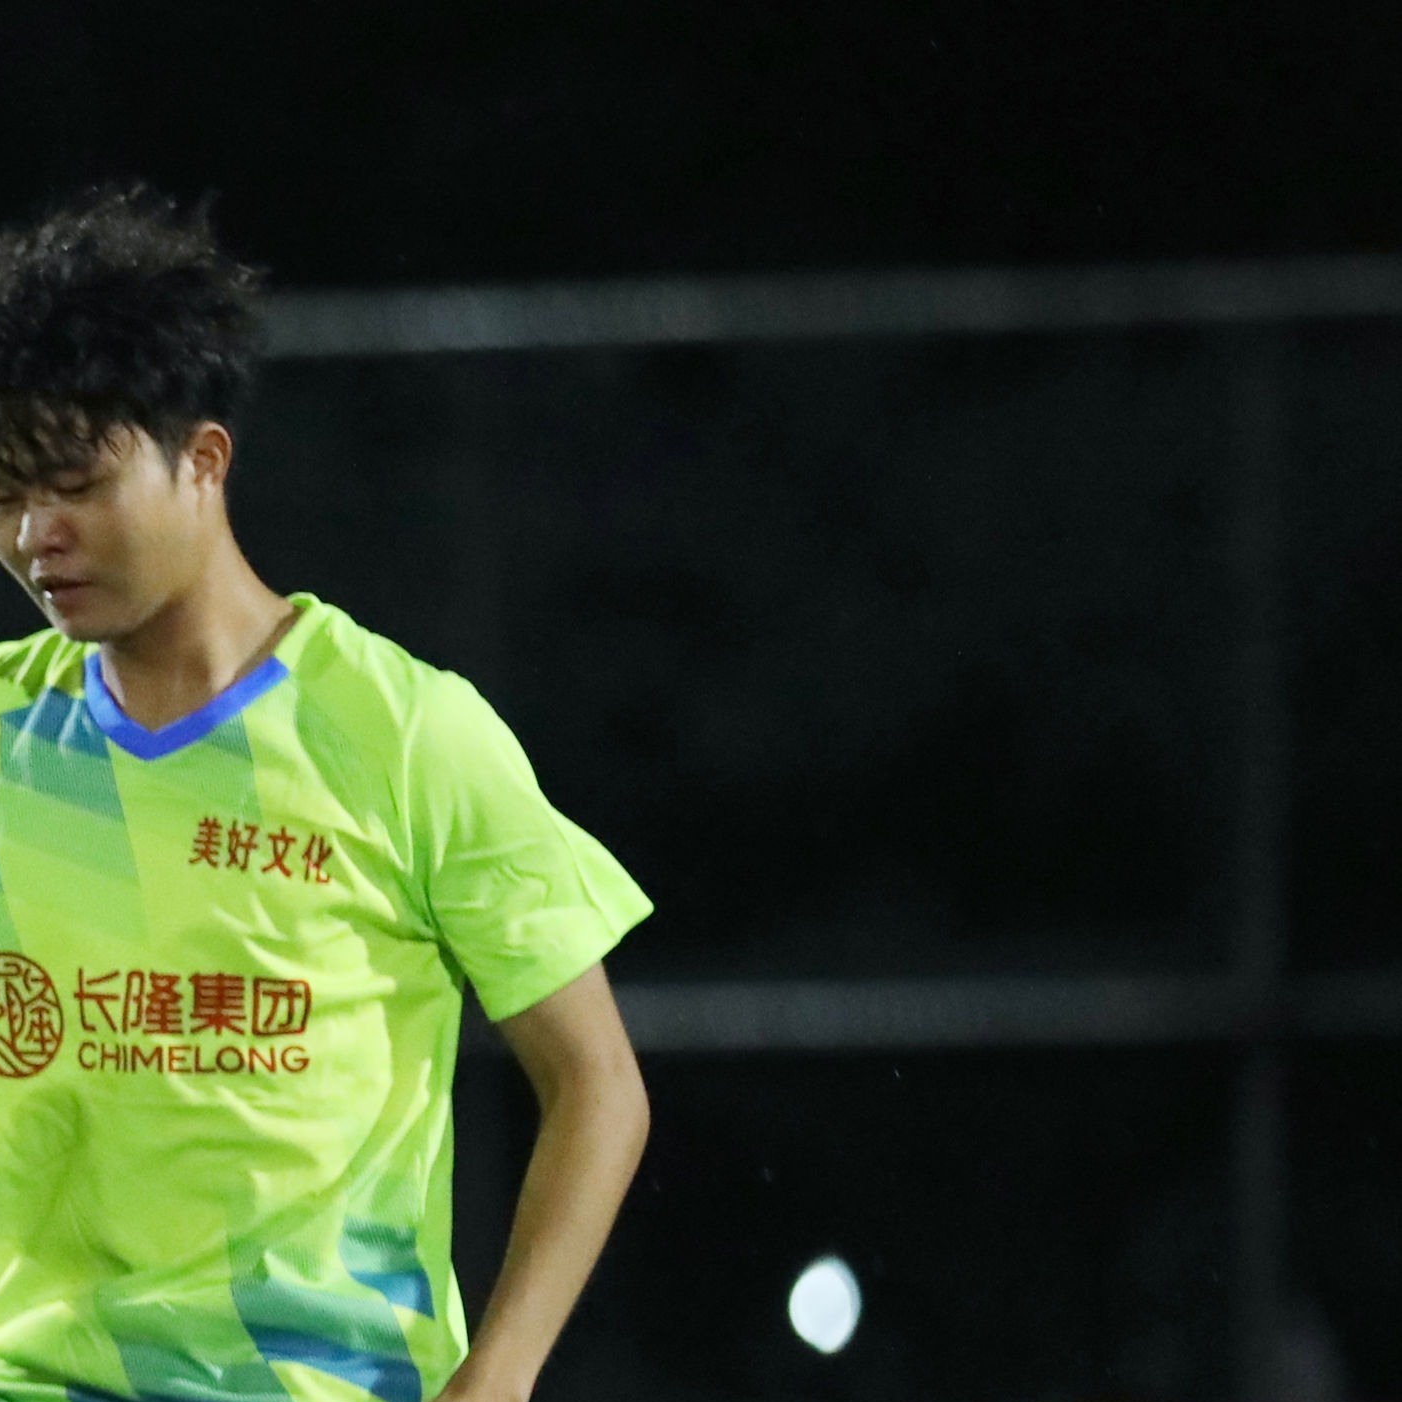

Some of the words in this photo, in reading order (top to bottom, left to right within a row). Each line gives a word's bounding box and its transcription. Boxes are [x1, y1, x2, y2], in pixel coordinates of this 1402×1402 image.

[188, 816, 334, 884] 美好文化
[74, 966, 312, 1038] 长隆集团
[78, 1041, 311, 1075] CHIMELONG
